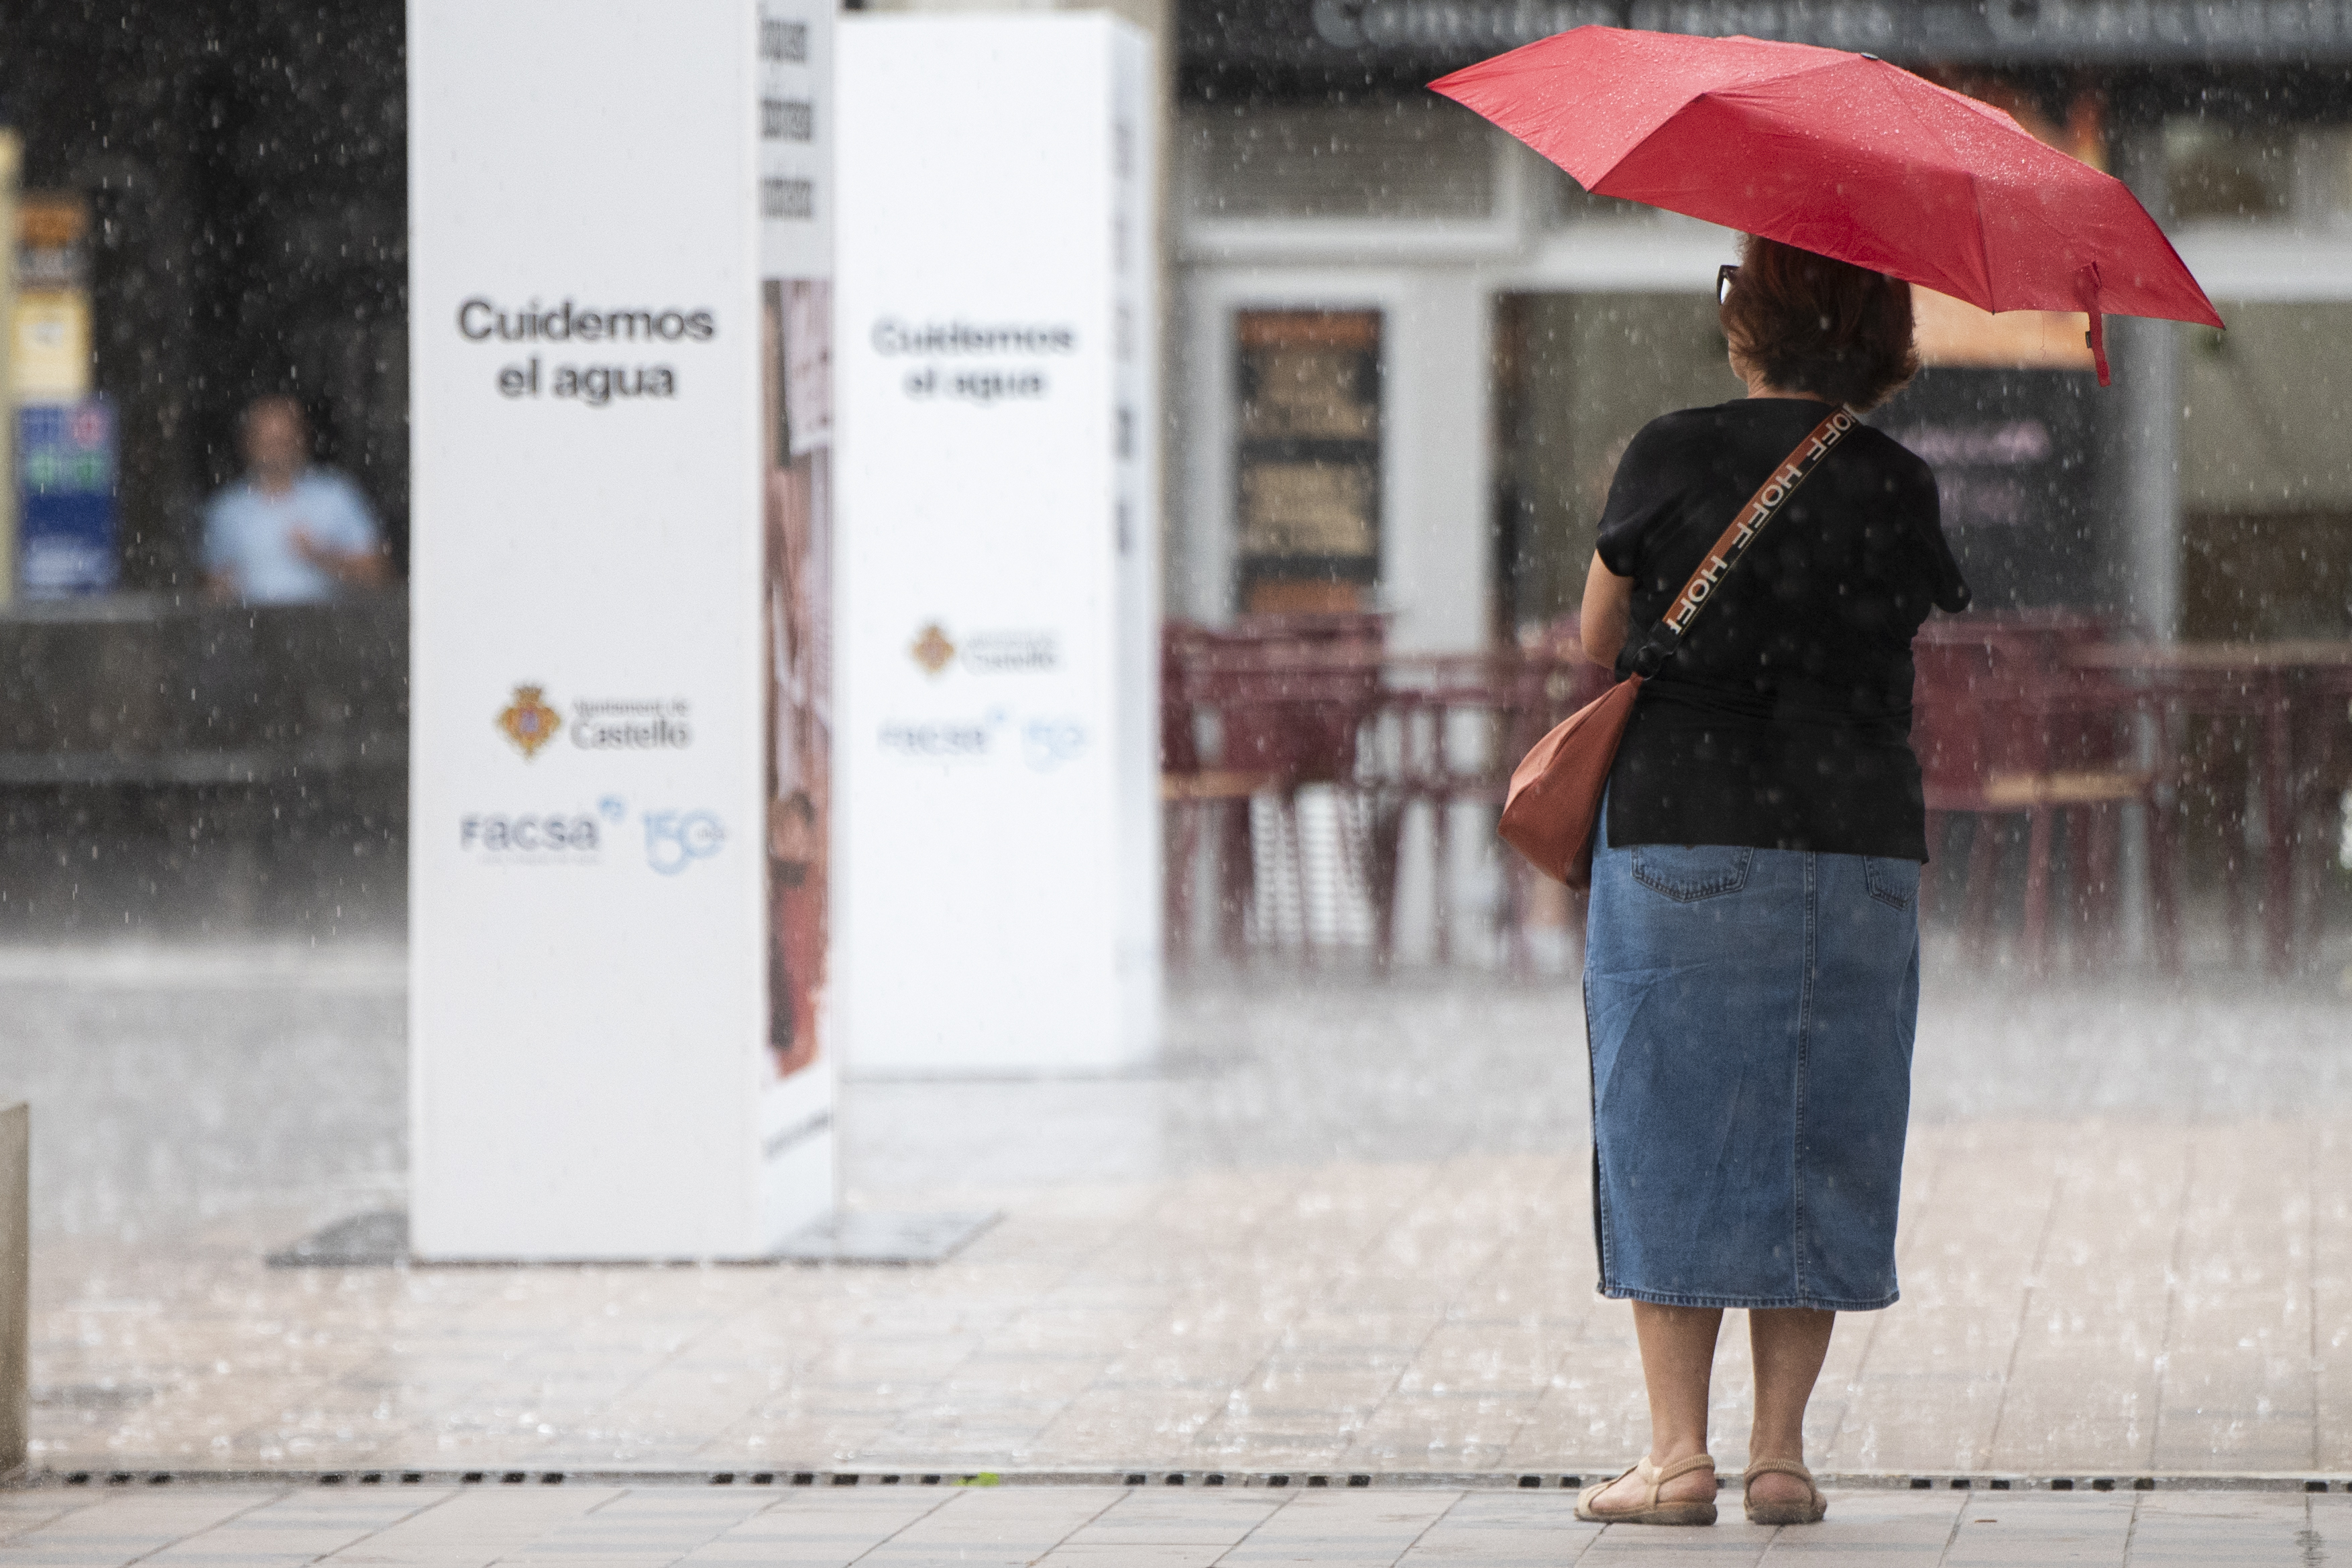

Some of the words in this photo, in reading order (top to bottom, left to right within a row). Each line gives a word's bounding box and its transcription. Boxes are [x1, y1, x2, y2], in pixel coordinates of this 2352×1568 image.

[457, 298, 716, 342] Cuidemos
[873, 319, 1076, 355] Cuidemos
[497, 355, 541, 398] el
[553, 366, 676, 406] agua
[903, 365, 940, 398] el
[951, 371, 1046, 406] agua
[1807, 403, 1856, 461] HOFF
[1732, 464, 1802, 549] HOFF
